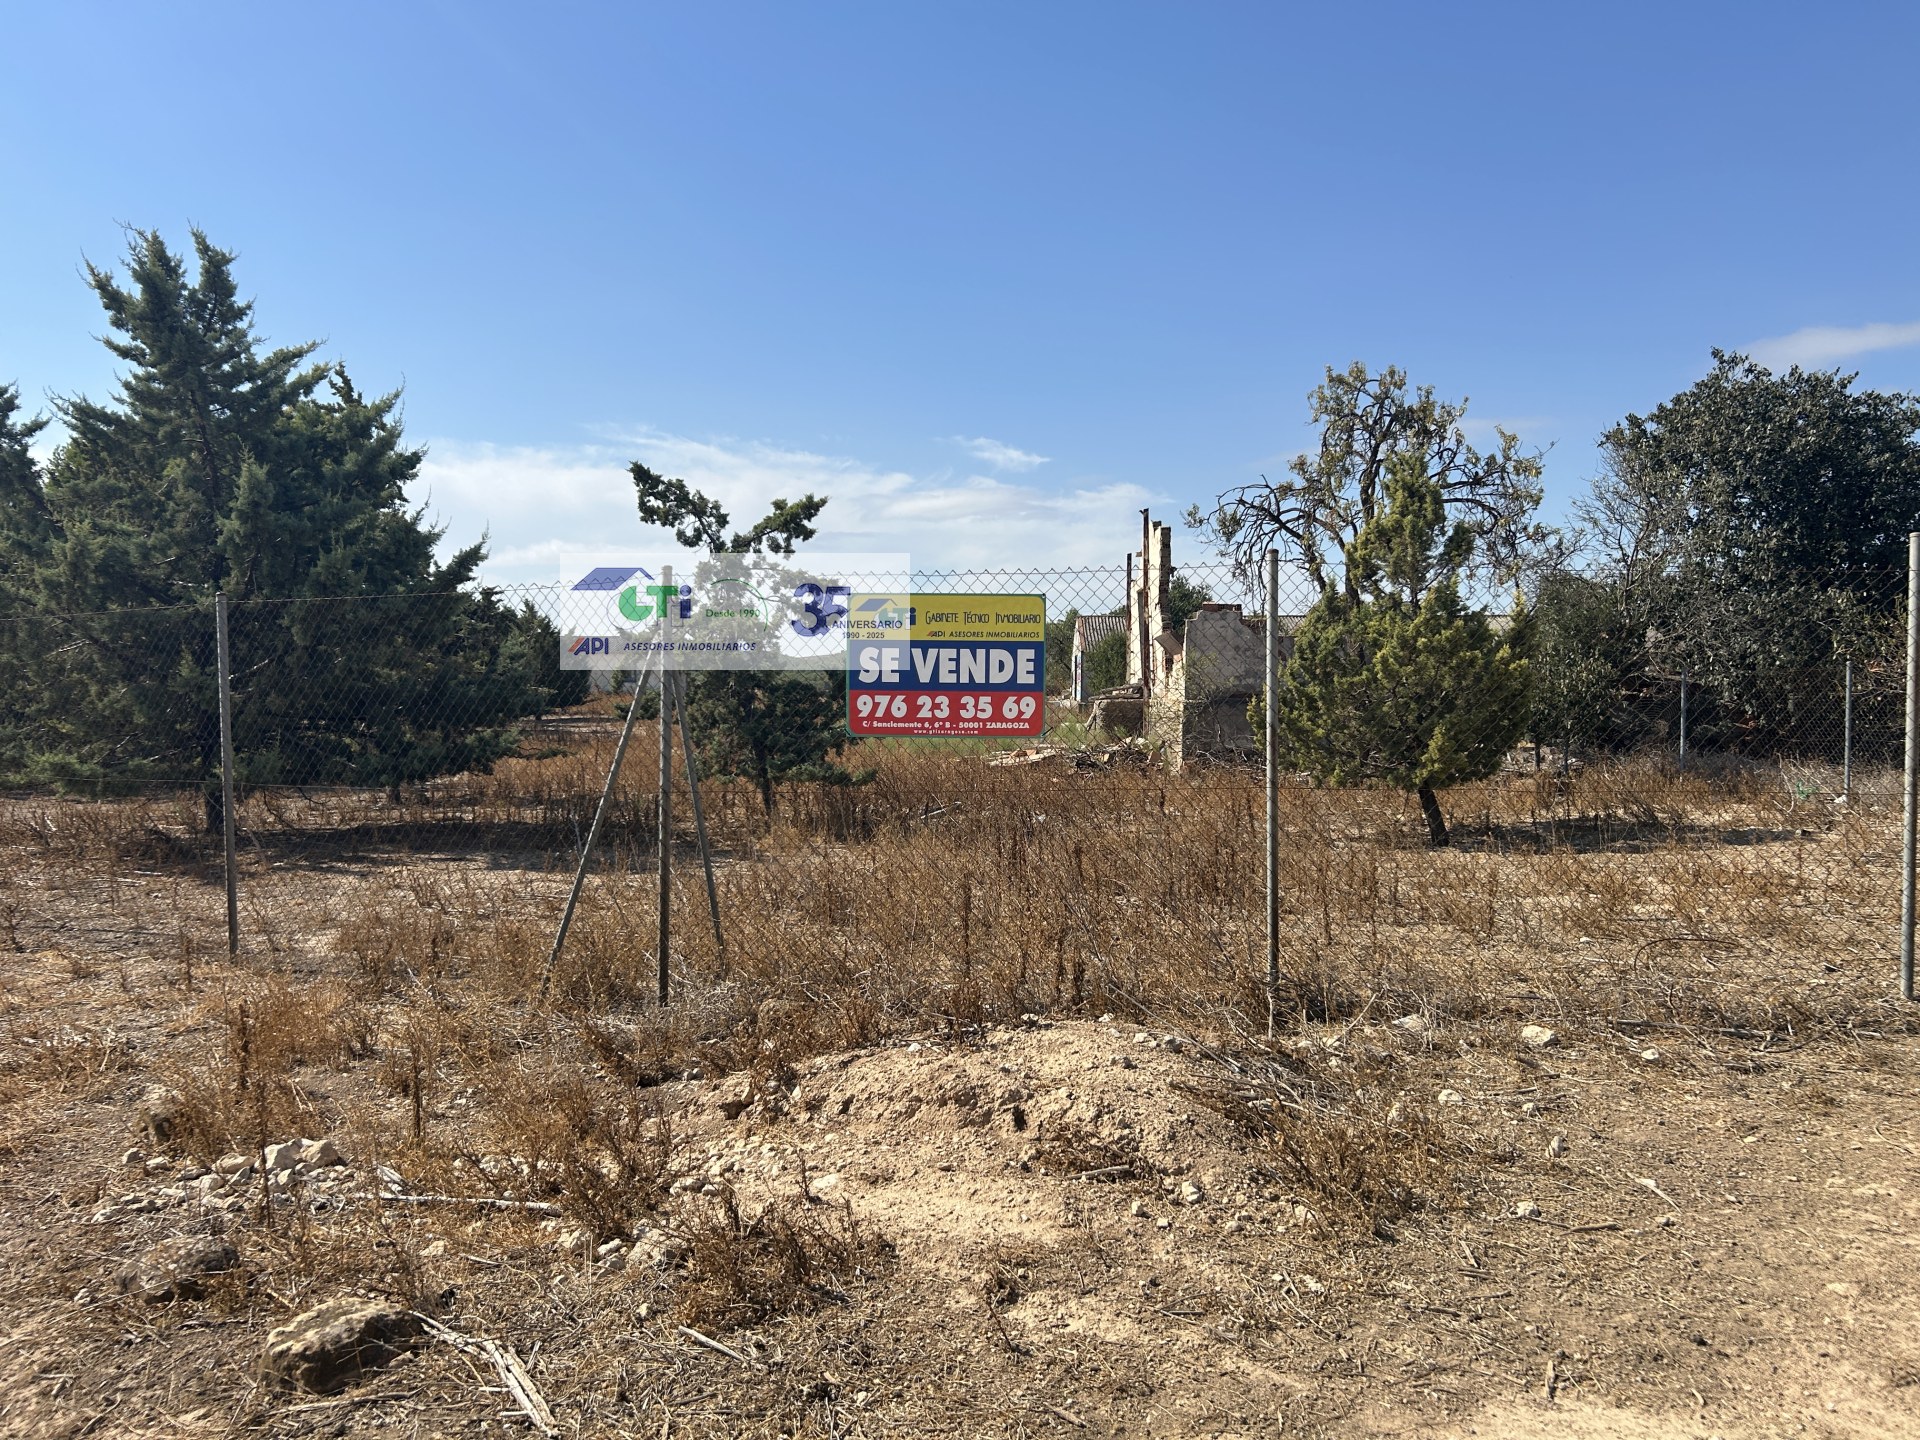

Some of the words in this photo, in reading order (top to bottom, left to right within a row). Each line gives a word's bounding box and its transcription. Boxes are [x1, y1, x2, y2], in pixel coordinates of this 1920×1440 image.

[930, 630, 946, 638] API
[858, 647, 900, 683] SE
[911, 648, 1035, 684] VENDE
[856, 694, 908, 718] 976
[916, 695, 950, 719] 23
[959, 696, 993, 719] 35
[1002, 696, 1036, 719] 69
